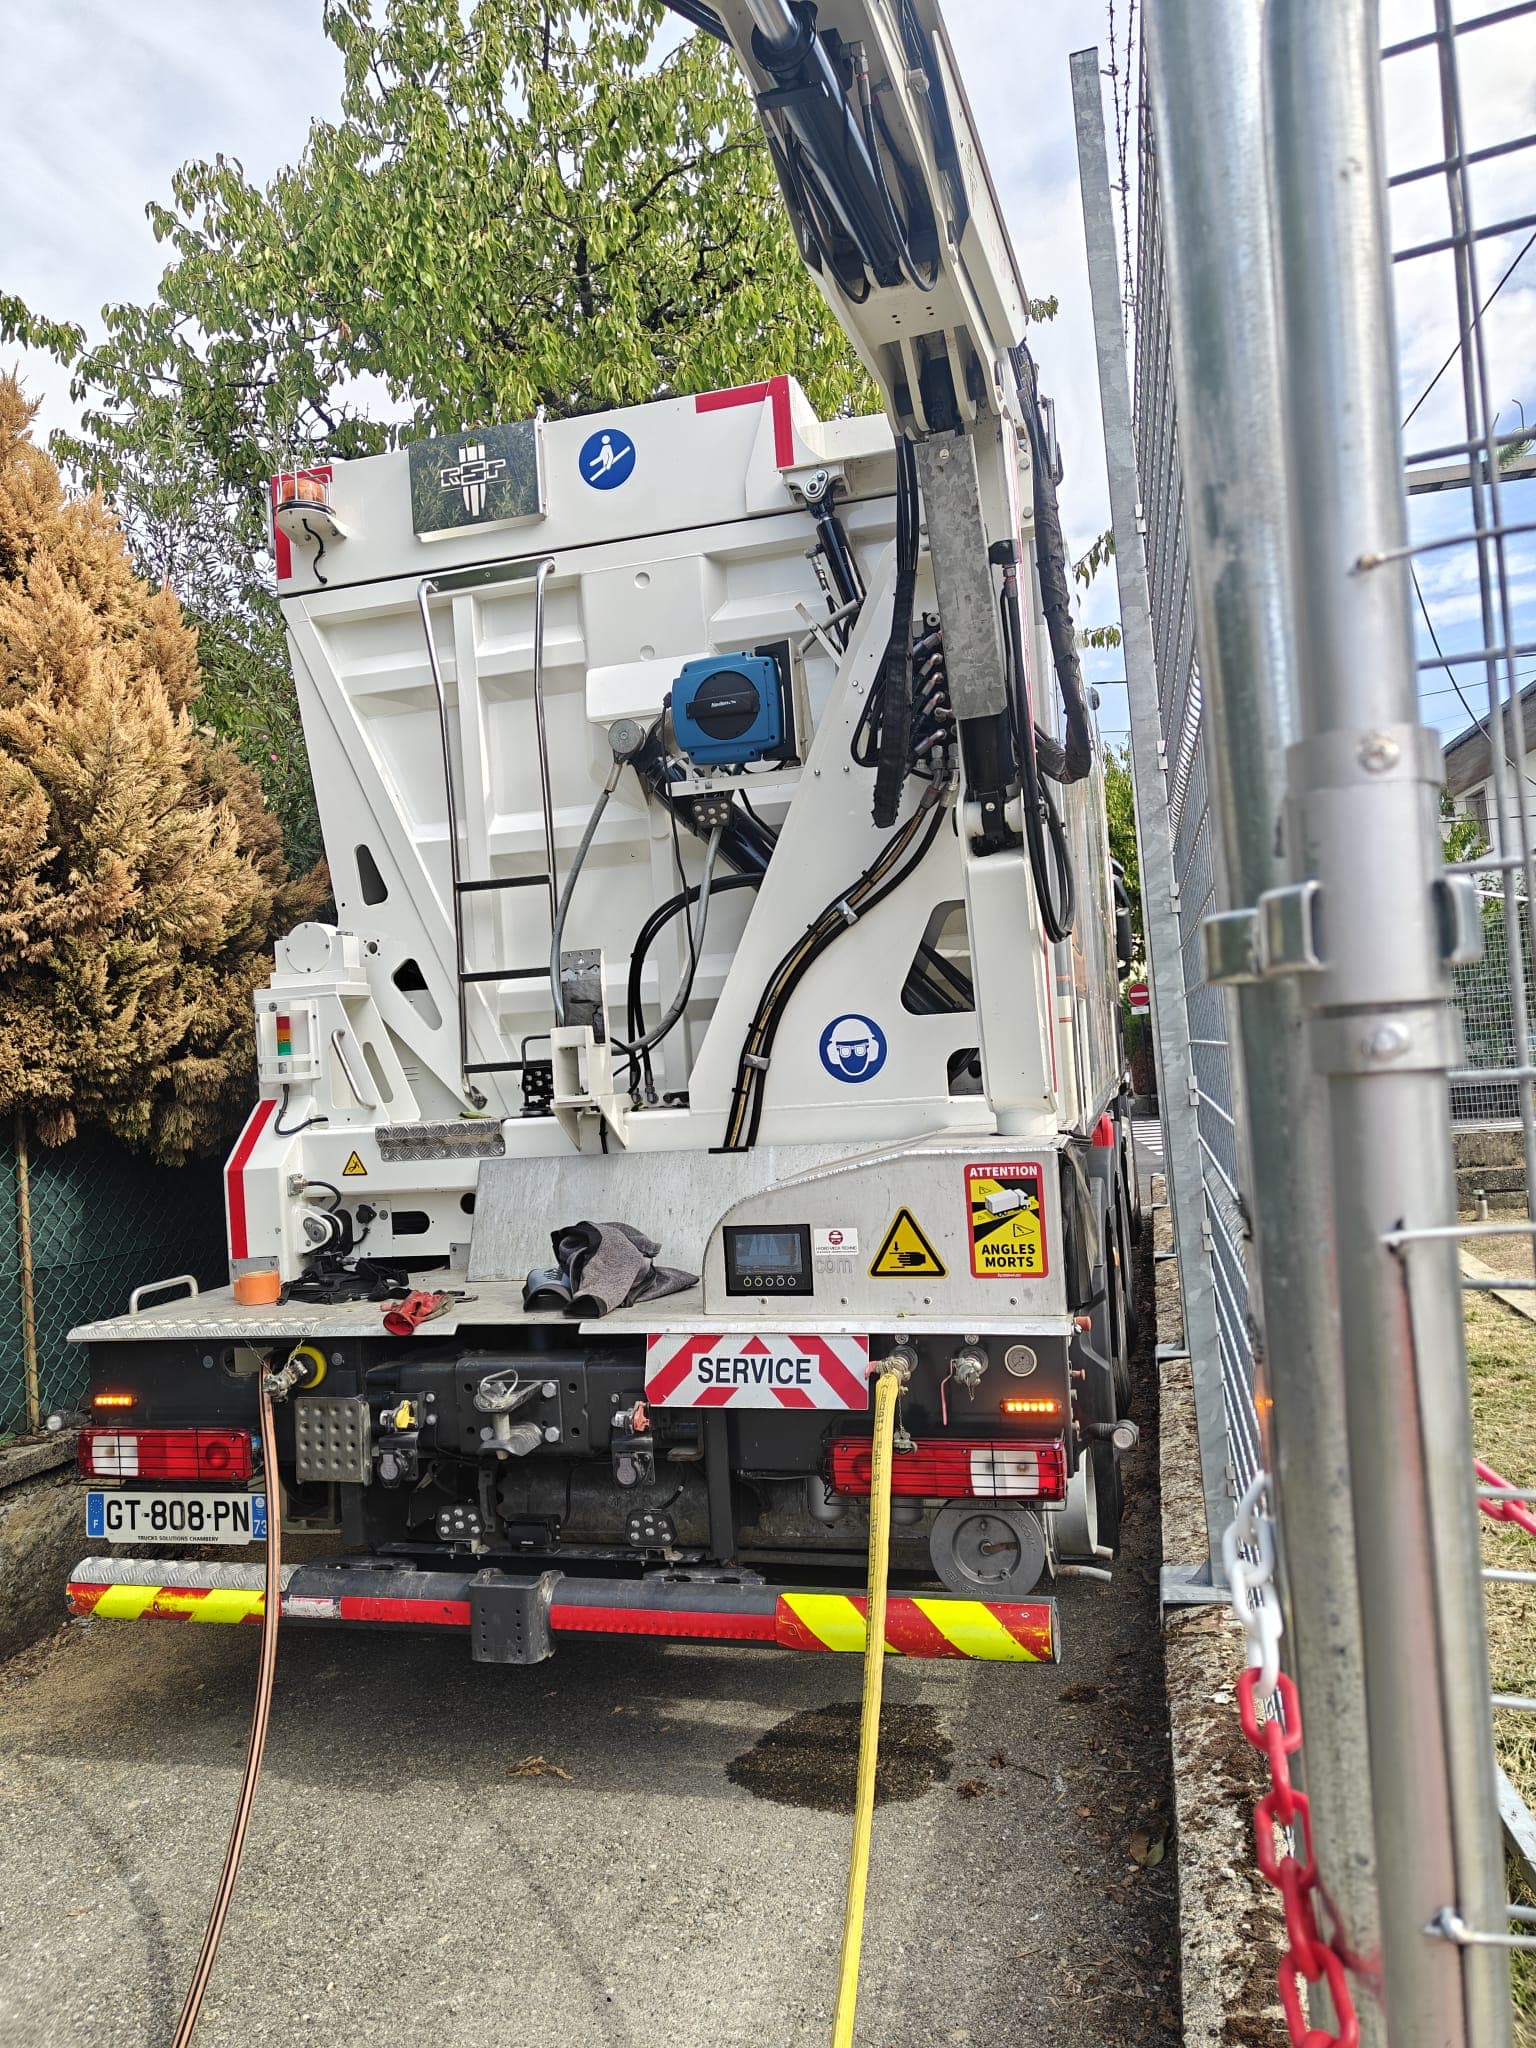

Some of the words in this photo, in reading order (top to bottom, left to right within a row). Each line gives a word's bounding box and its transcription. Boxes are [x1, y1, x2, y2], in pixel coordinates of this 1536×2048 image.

[970, 1166, 1038, 1177] ATTENTION
[982, 1243, 1036, 1255] ANGLES
[985, 1256, 1034, 1268] MORTS
[697, 1357, 812, 1384] SERVICE
[106, 1499, 250, 1532] GT-808-PN
[93, 1519, 99, 1529] F
[253, 1519, 267, 1535] 73
